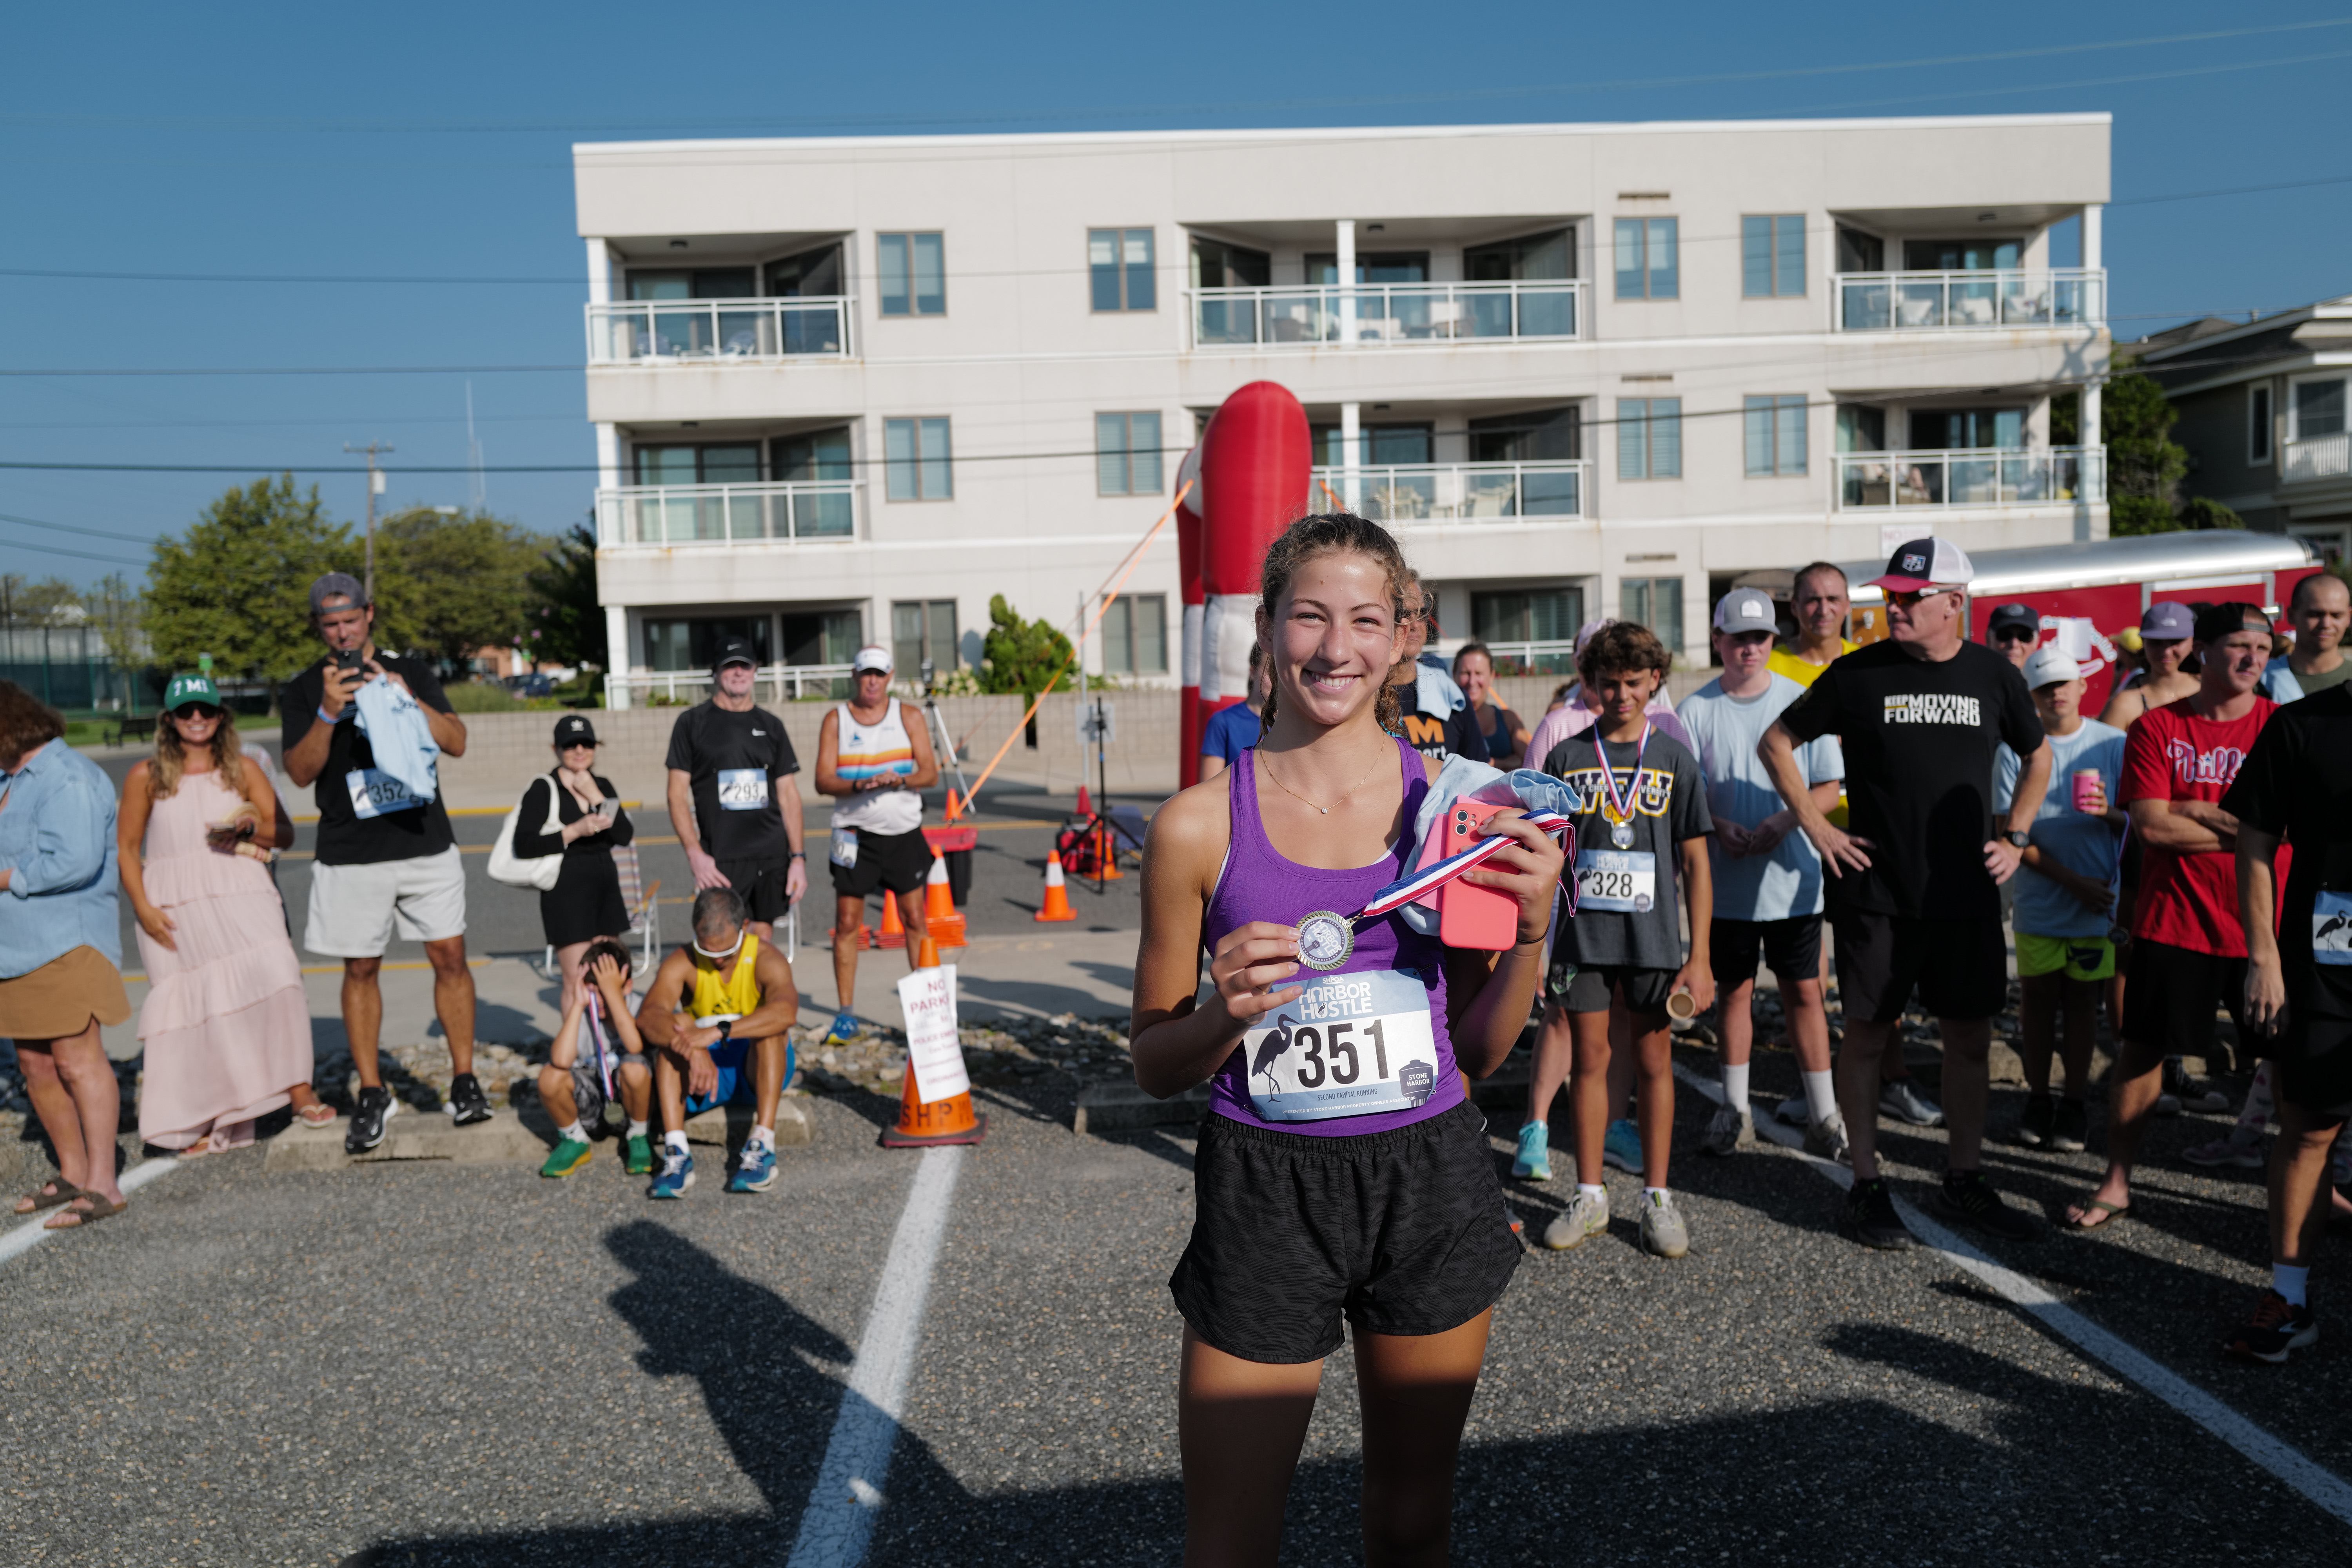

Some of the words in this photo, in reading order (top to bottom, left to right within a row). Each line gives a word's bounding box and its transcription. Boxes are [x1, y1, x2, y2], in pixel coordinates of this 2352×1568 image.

[1884, 695, 1908, 707] KEEP
[1908, 694, 1980, 714] MOVING
[1884, 707, 1980, 726] FORWARD
[371, 782, 405, 804] 352
[735, 783, 758, 800] 293
[1589, 784, 1624, 793] CHESR
[1593, 872, 1632, 897] 328
[1301, 921, 1315, 937] PROPERTY
[1316, 919, 1342, 953] HARBOR
[1300, 939, 1308, 955] OWNERS
[1310, 923, 1335, 957] HUSTLE
[1317, 949, 1324, 957] 1M
[927, 978, 946, 993] NO
[1299, 982, 1372, 1004] HARBOR
[1300, 997, 1373, 1020] HUSTLE
[1294, 1019, 1389, 1088] 351
[1357, 1088, 1377, 1096] RUNNING
[1407, 1078, 1430, 1087] HARBOR
